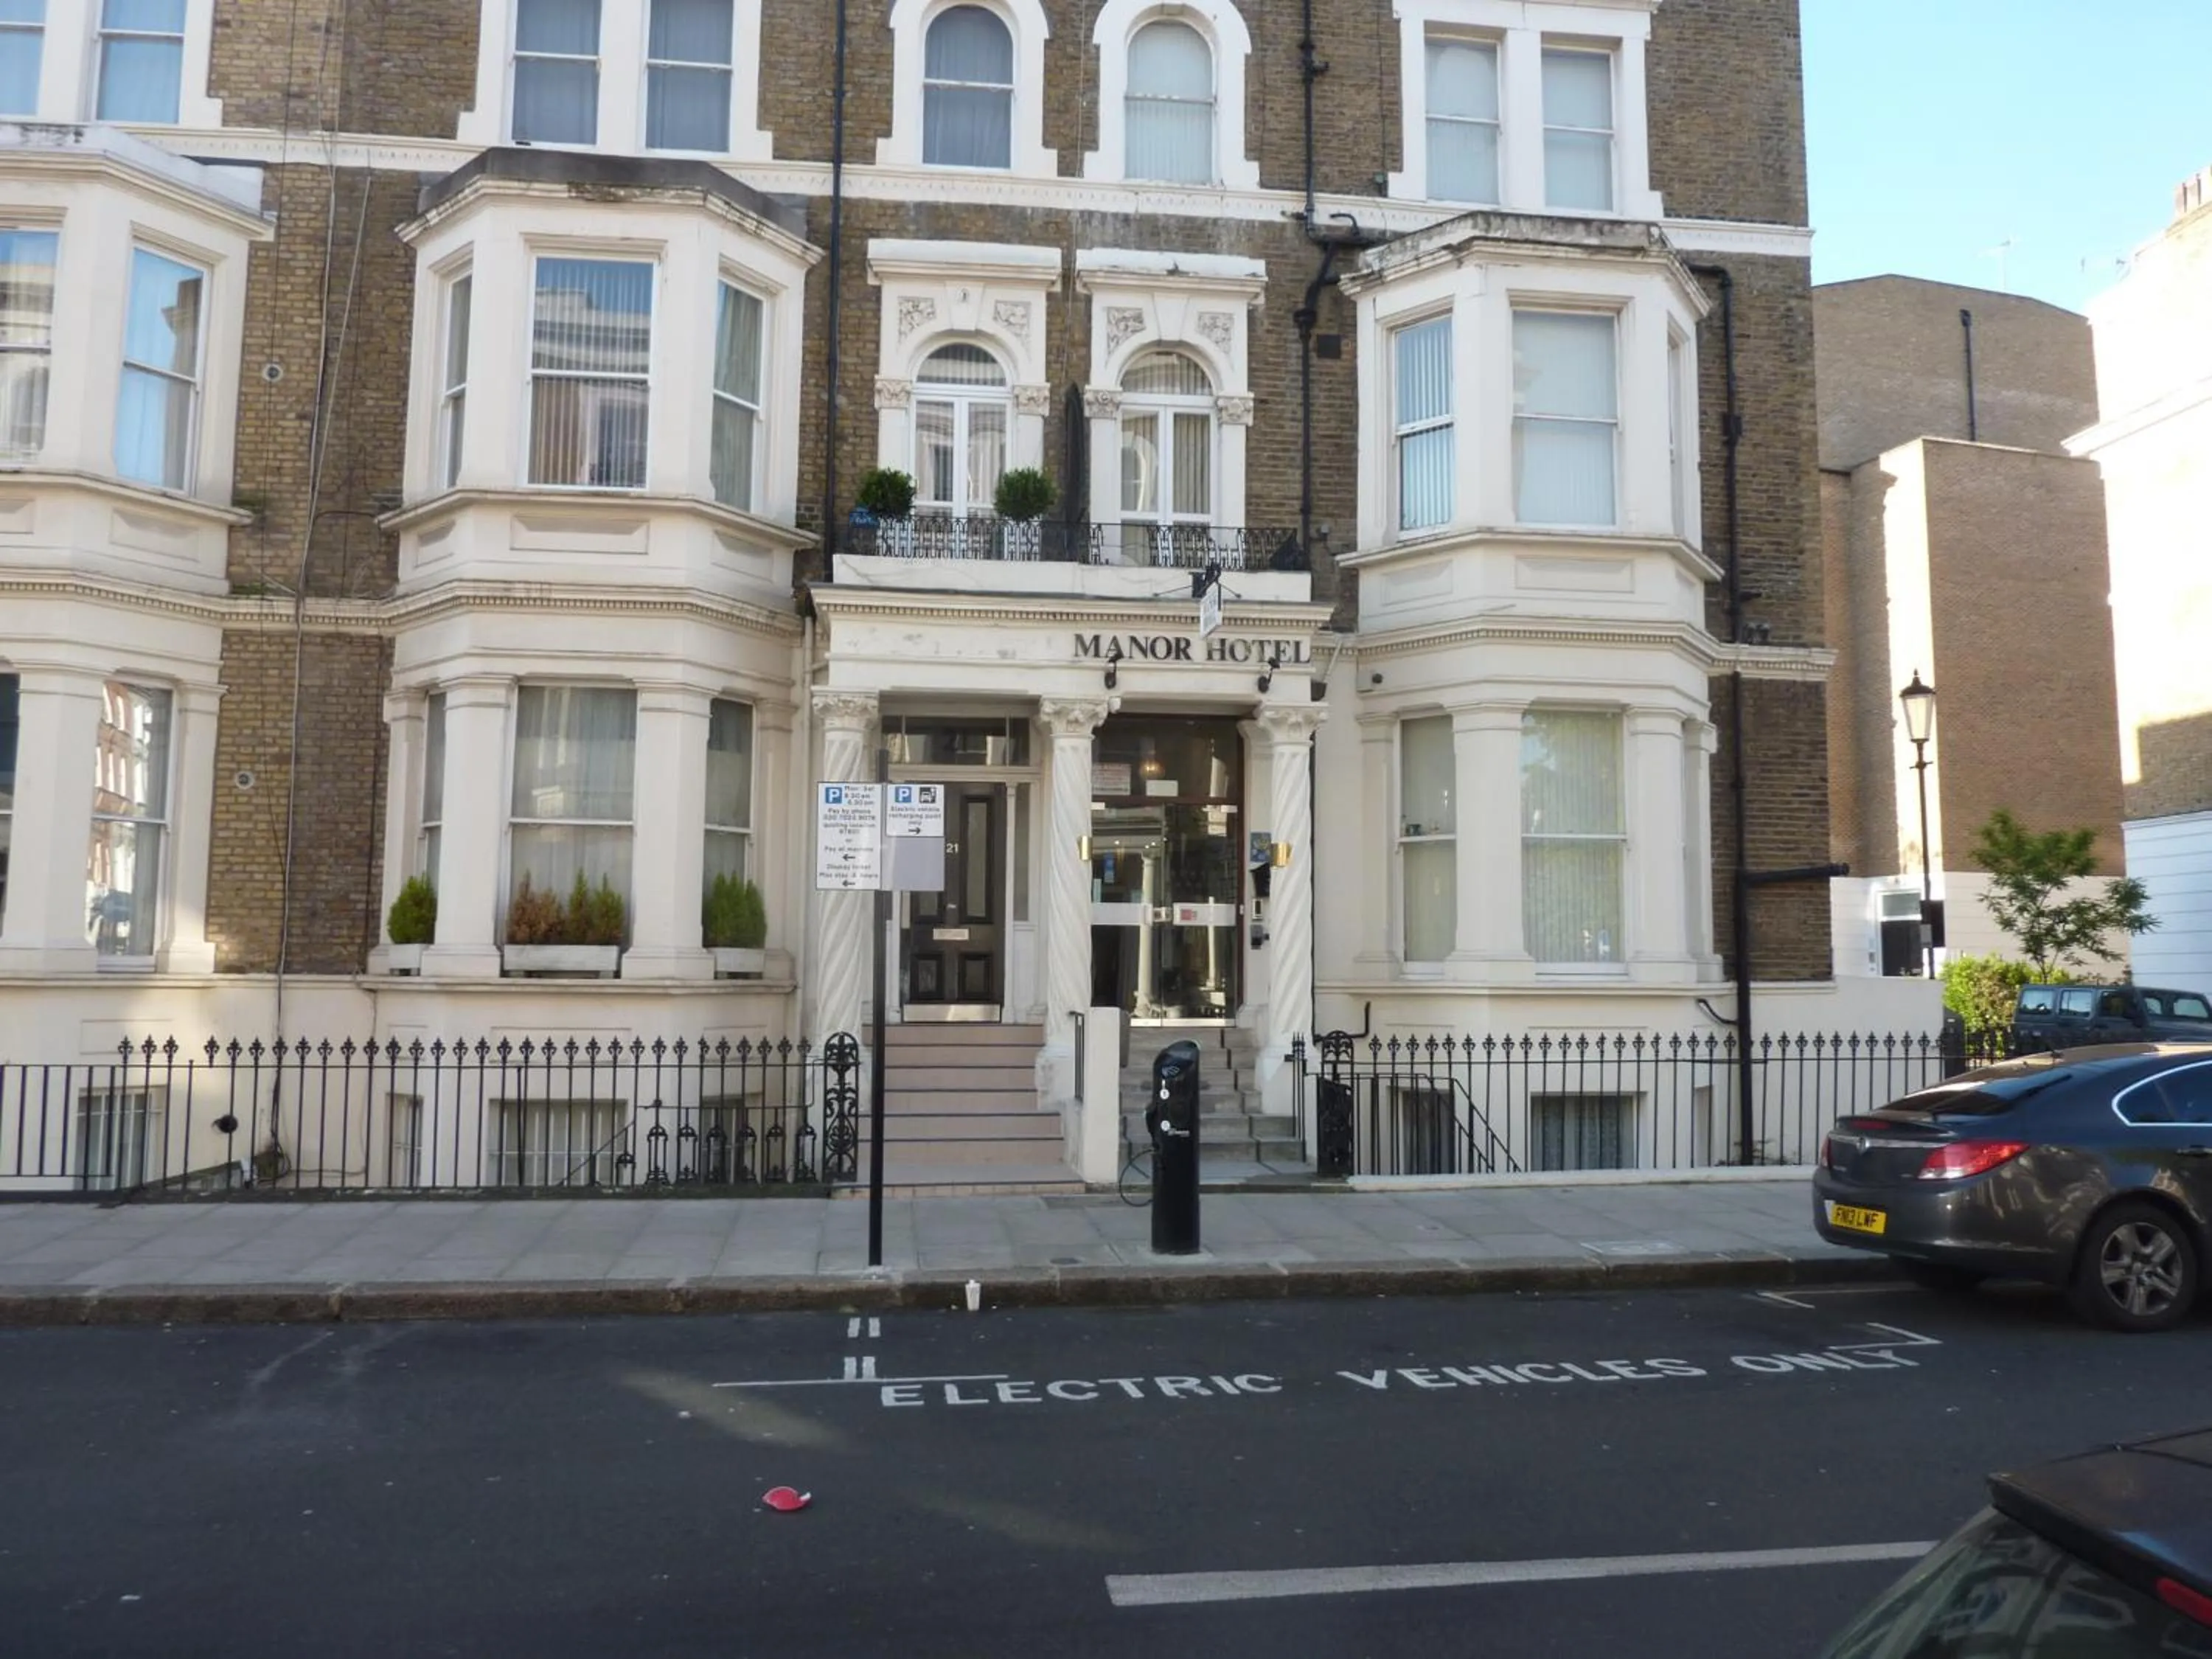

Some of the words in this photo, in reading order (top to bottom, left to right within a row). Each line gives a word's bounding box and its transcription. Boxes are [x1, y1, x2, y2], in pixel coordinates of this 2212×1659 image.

[1074, 633, 1192, 661] MANOR
[1207, 637, 1311, 664] HOTEL
[946, 843, 959, 853] 21
[880, 1373, 1283, 1407] ELECTRIC
[1336, 1357, 1707, 1390] VEHICLES
[1729, 1348, 1920, 1373] ONLY
